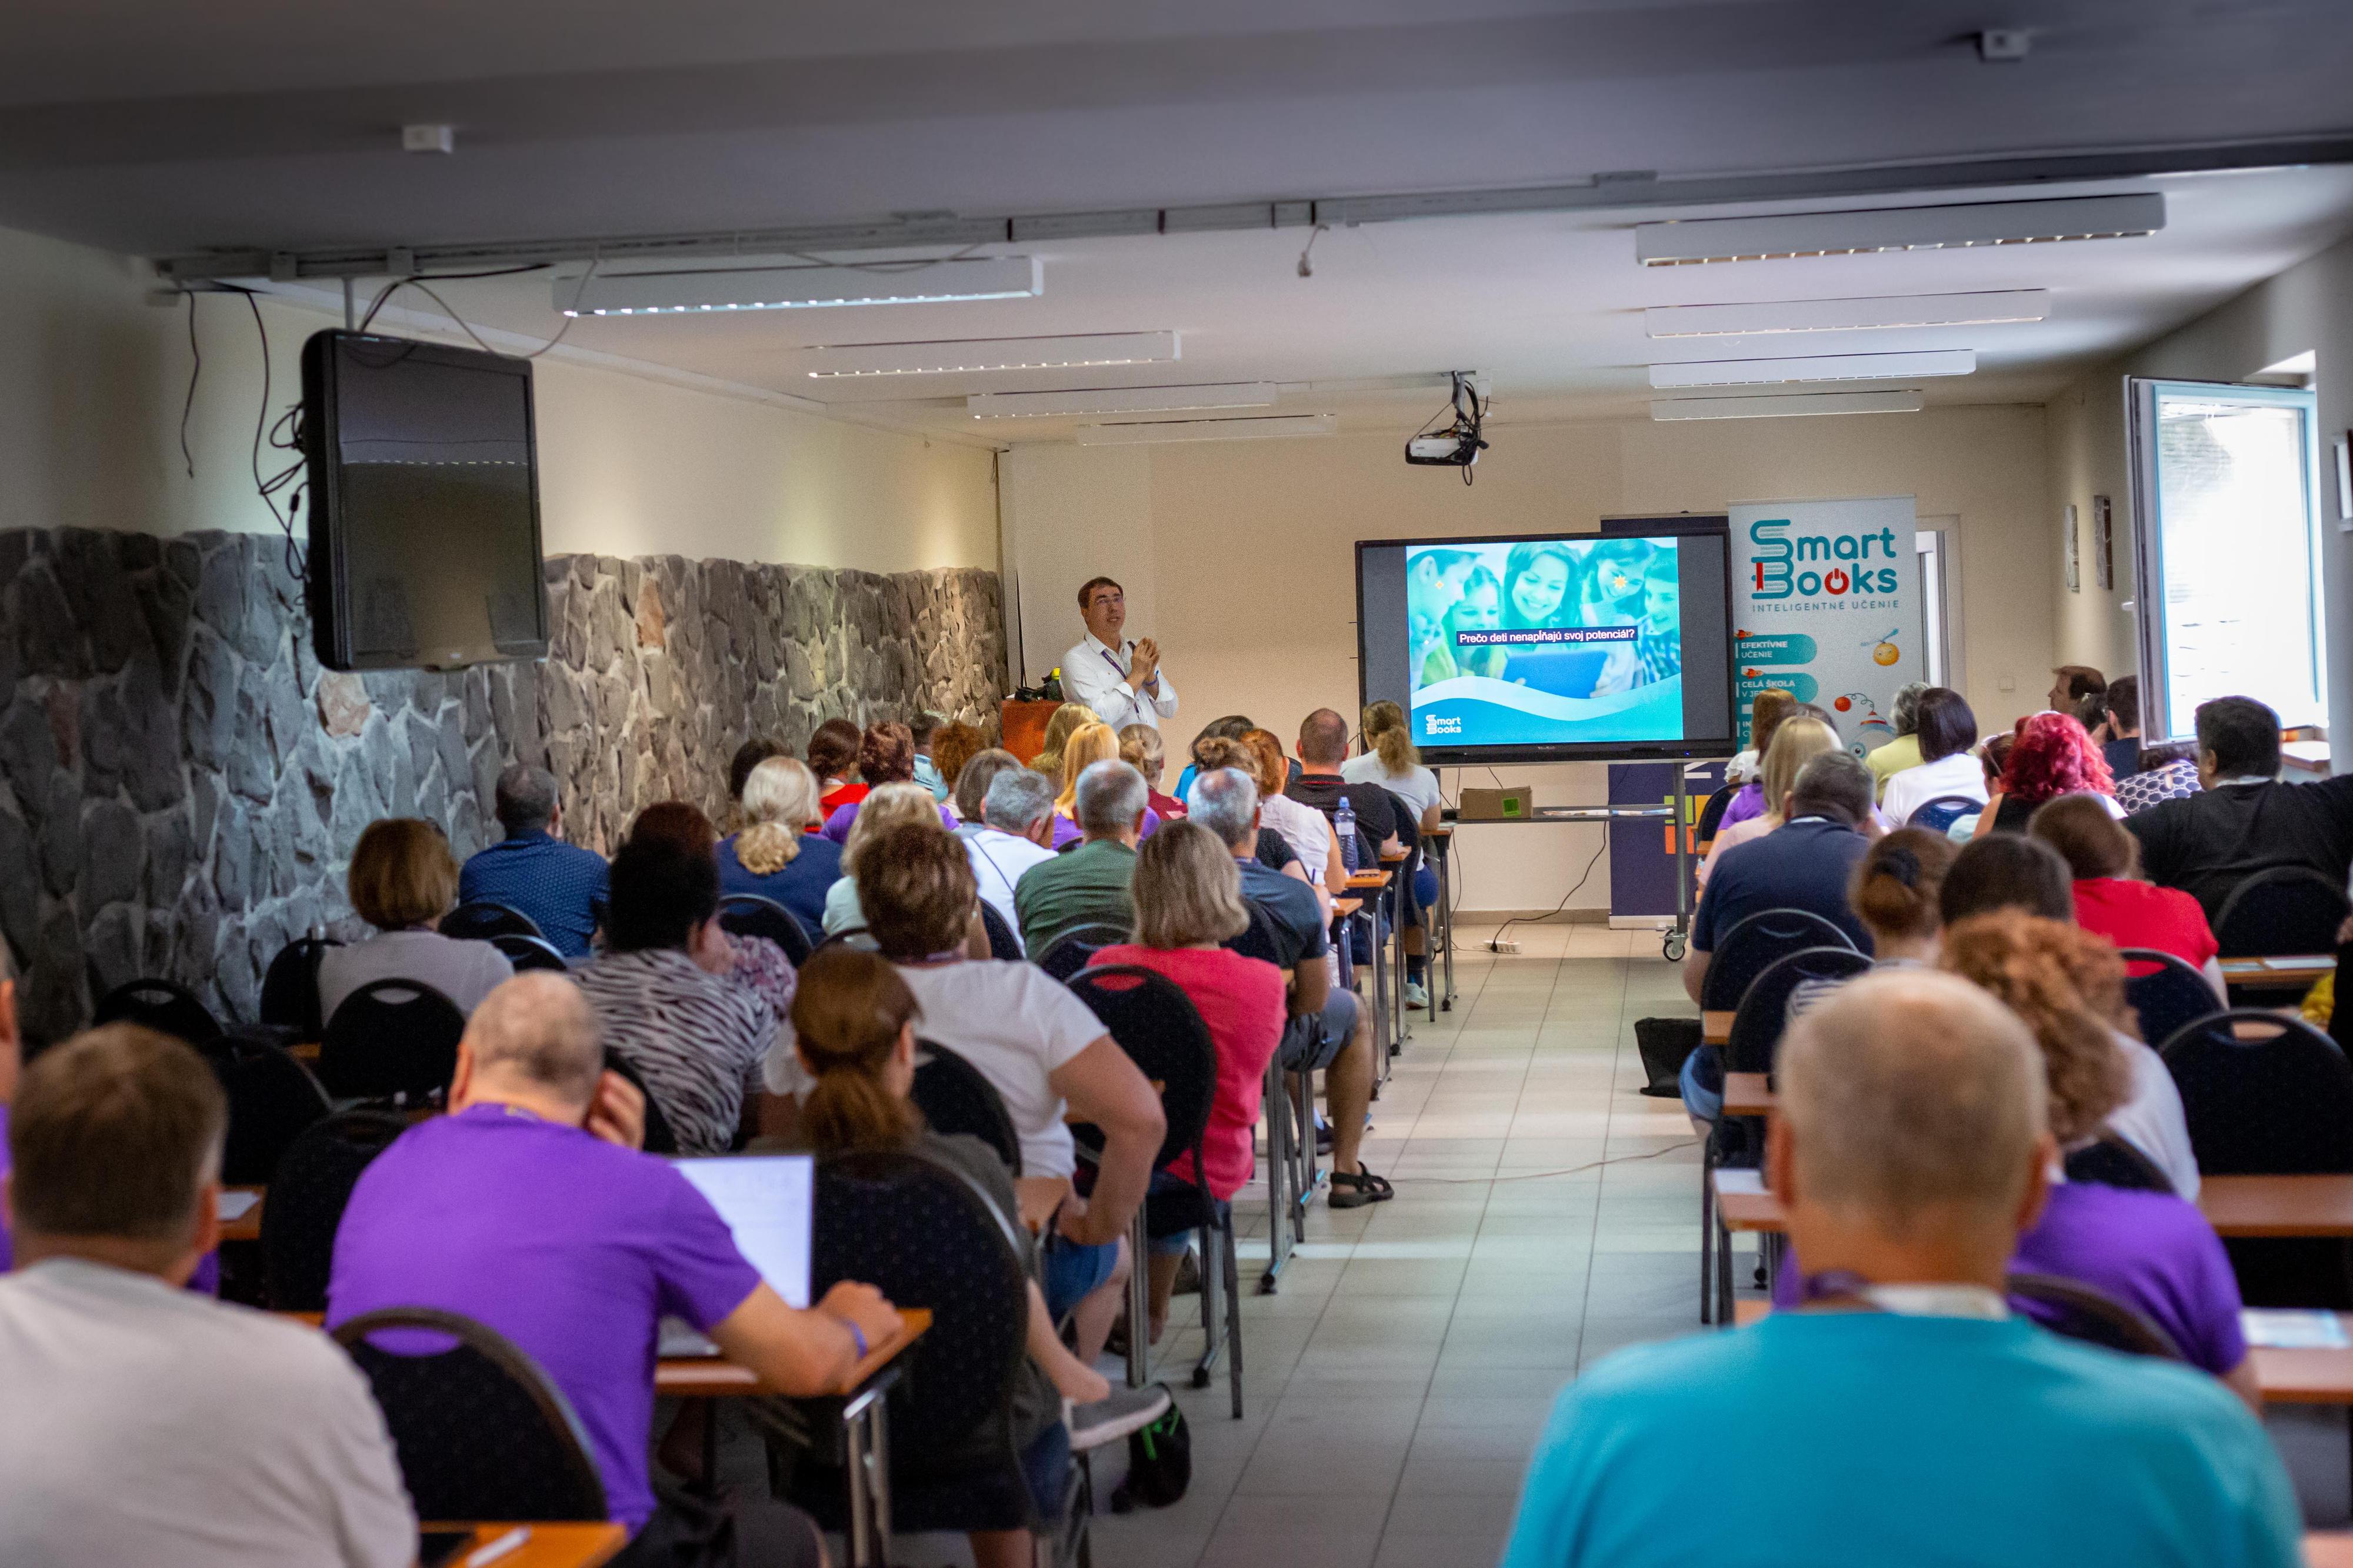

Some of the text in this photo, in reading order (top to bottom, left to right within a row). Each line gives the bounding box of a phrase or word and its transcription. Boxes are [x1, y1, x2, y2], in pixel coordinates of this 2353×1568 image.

[1750, 519, 1897, 562] Smart
[1751, 557, 1898, 600] Books
[1752, 599, 1899, 612] INTELIGENTNÉ UČENIE
[1459, 633, 1488, 643] Prečo
[1489, 633, 1508, 642] deti
[1564, 630, 1584, 641] svoj
[1585, 629, 1635, 642] potenciál?
[1741, 640, 1788, 649] EFEKTÍVNE
[1741, 650, 1772, 658] UČENIE
[1426, 715, 1461, 725] Smart
[1426, 723, 1462, 735] Books
